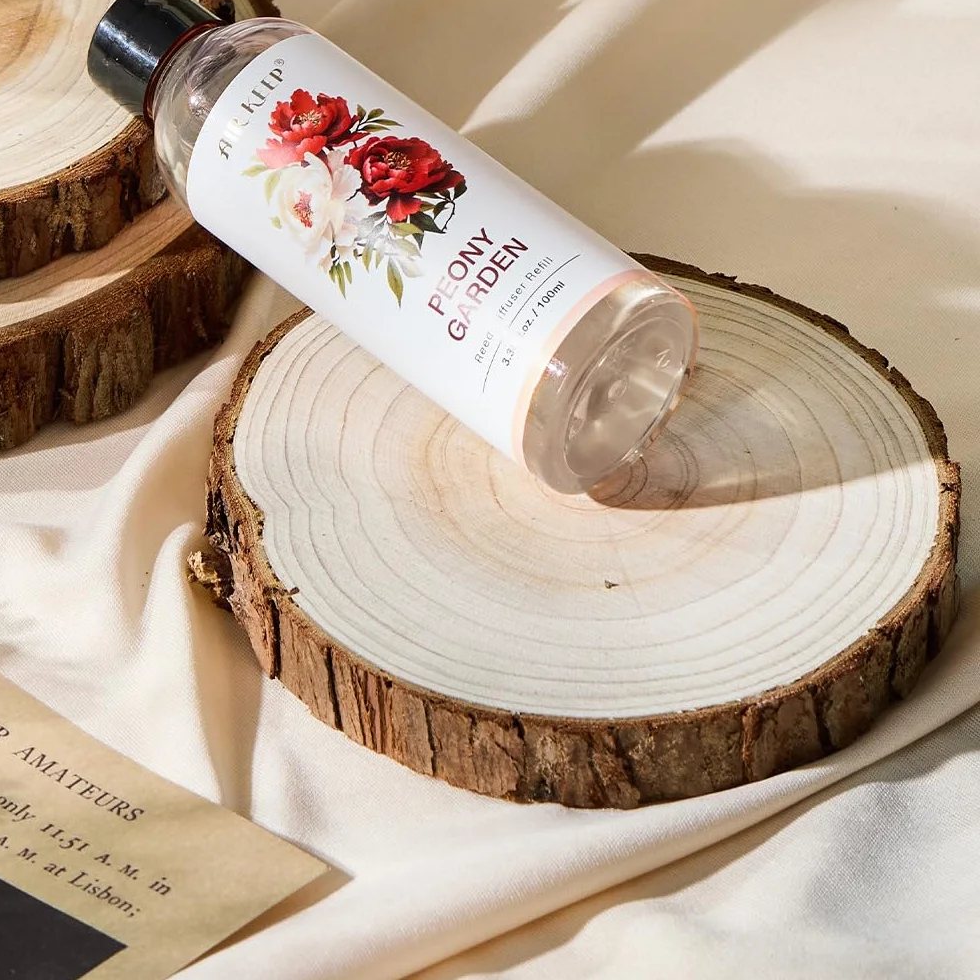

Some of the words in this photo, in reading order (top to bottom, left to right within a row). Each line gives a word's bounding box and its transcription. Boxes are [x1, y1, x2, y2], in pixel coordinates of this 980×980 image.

[427, 227, 494, 316] PEONY
[447, 237, 529, 341] GARDEN
[497, 282, 526, 320] iffuser
[525, 256, 553, 282] Refill
[501, 347, 515, 367] 3.3
[537, 281, 565, 309] 100ml
[12, 746, 145, 822] AMATEURS
[17, 848, 36, 864] M.
[44, 861, 67, 877] at
[68, 871, 141, 919] Lisbon;
[40, 823, 90, 852] 11.51
[94, 853, 112, 866] A.
[118, 864, 139, 881] M.
[149, 877, 172, 896] in
